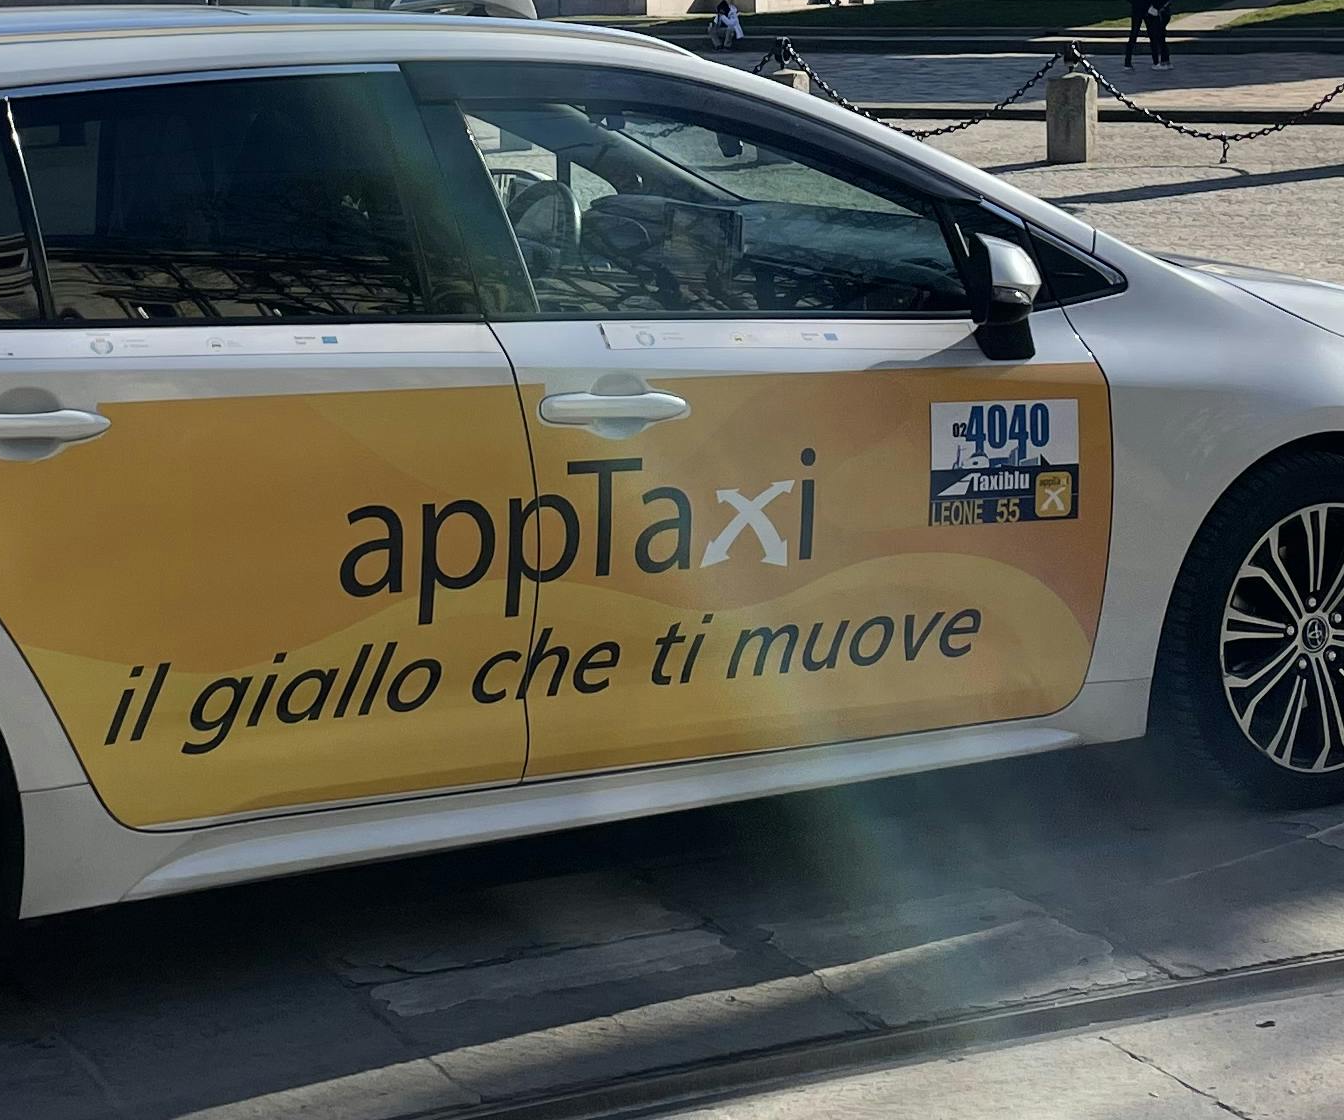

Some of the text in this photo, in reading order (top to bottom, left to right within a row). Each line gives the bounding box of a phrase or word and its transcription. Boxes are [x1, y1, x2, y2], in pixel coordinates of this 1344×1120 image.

[952, 402, 1050, 467] 02 4040
[930, 498, 1021, 526] LEONE 55
[971, 469, 1030, 492] Taxiblu
[338, 446, 817, 626] appTaxi
[103, 607, 983, 756] il giallo che ti muove
